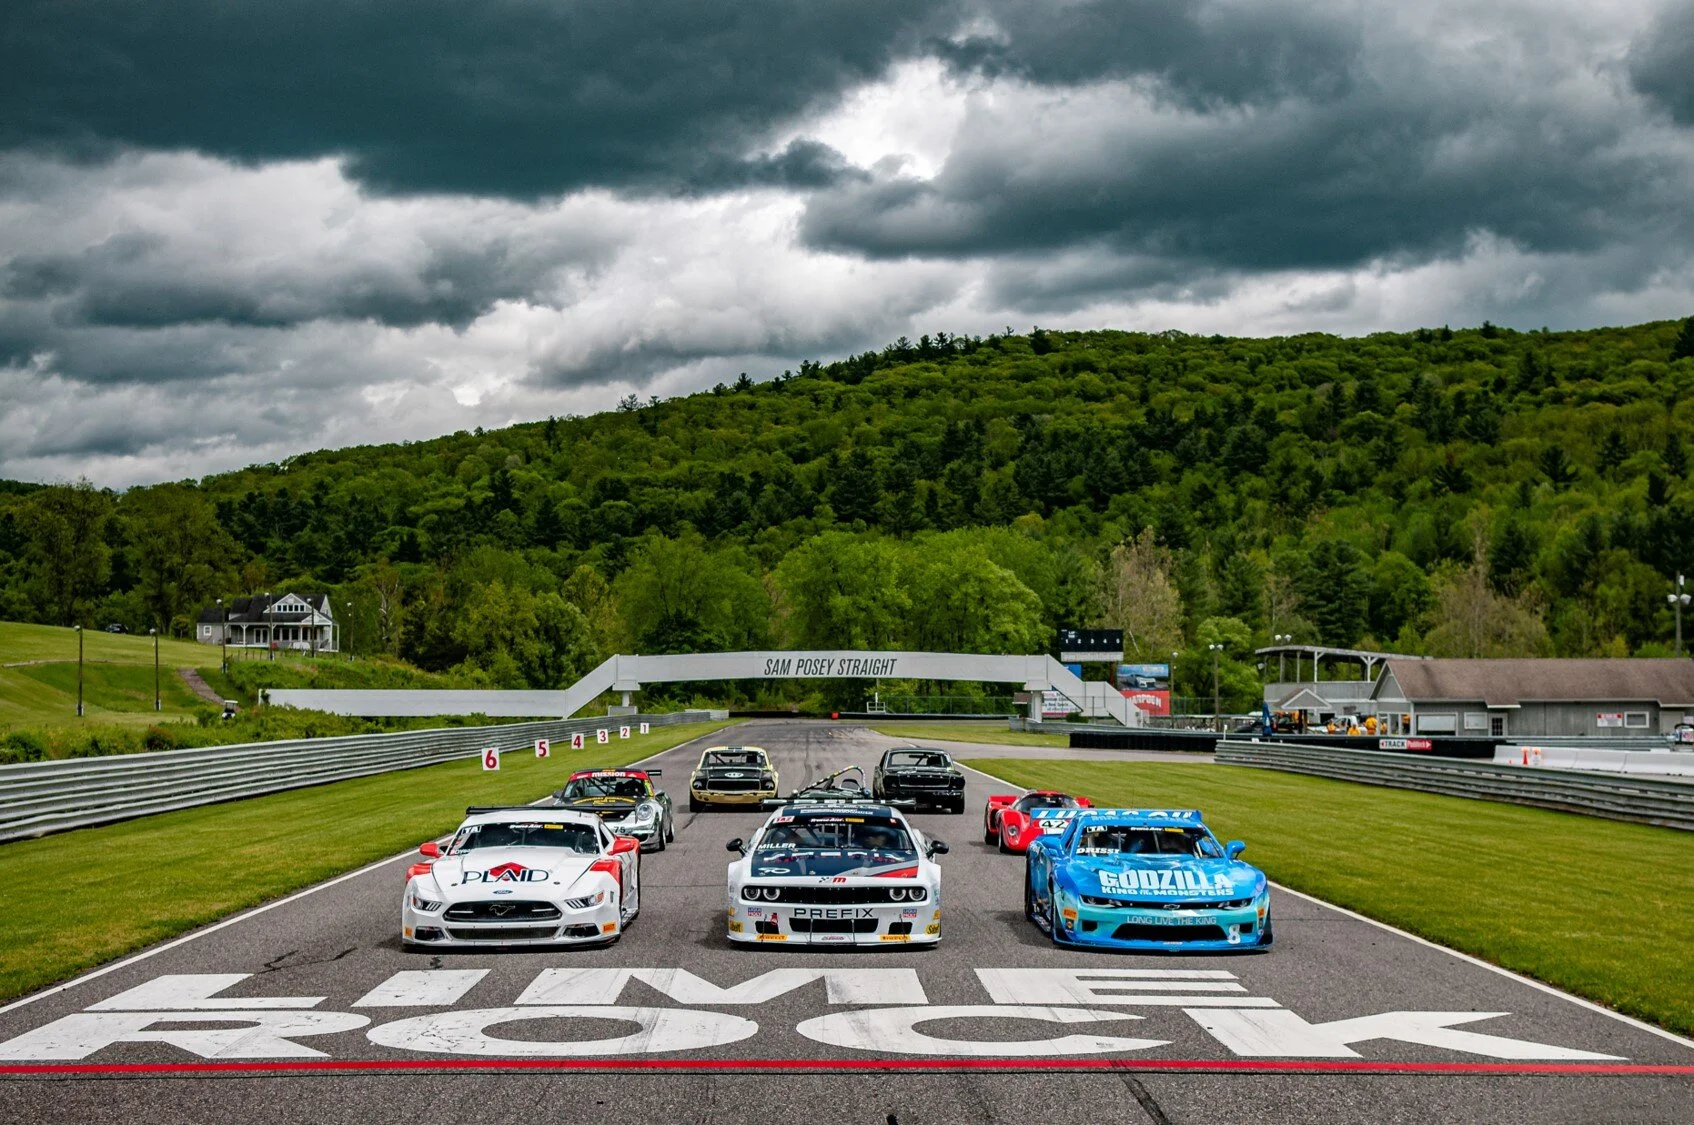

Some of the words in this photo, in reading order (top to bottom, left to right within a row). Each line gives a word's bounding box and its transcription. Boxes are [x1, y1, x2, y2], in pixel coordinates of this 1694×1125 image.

[764, 658, 791, 676] SAM
[795, 658, 835, 676] POSEY
[837, 658, 897, 676] STRAIGHT
[622, 728, 628, 737] 2
[642, 725, 647, 733] 1
[573, 735, 582, 748] 4
[599, 730, 607, 742] 3
[538, 741, 547, 757] 5
[1385, 740, 1405, 748] TRACK
[485, 750, 497, 769] 6
[465, 825, 478, 834] TA
[614, 826, 626, 834] 75
[461, 868, 550, 885] PLAID
[1098, 869, 1234, 890] GODZILLA
[1101, 886, 1138, 895] KING
[1153, 888, 1235, 896] MONSTERS
[794, 908, 874, 919] PREFIX
[1127, 915, 1153, 924] LONG
[1155, 917, 1174, 925] LIVE
[1177, 916, 1194, 925] THE
[1195, 915, 1217, 924] KING
[1227, 924, 1241, 944] 8
[85, 967, 1282, 1012] LIME
[0, 1004, 1630, 1061] ROCK
